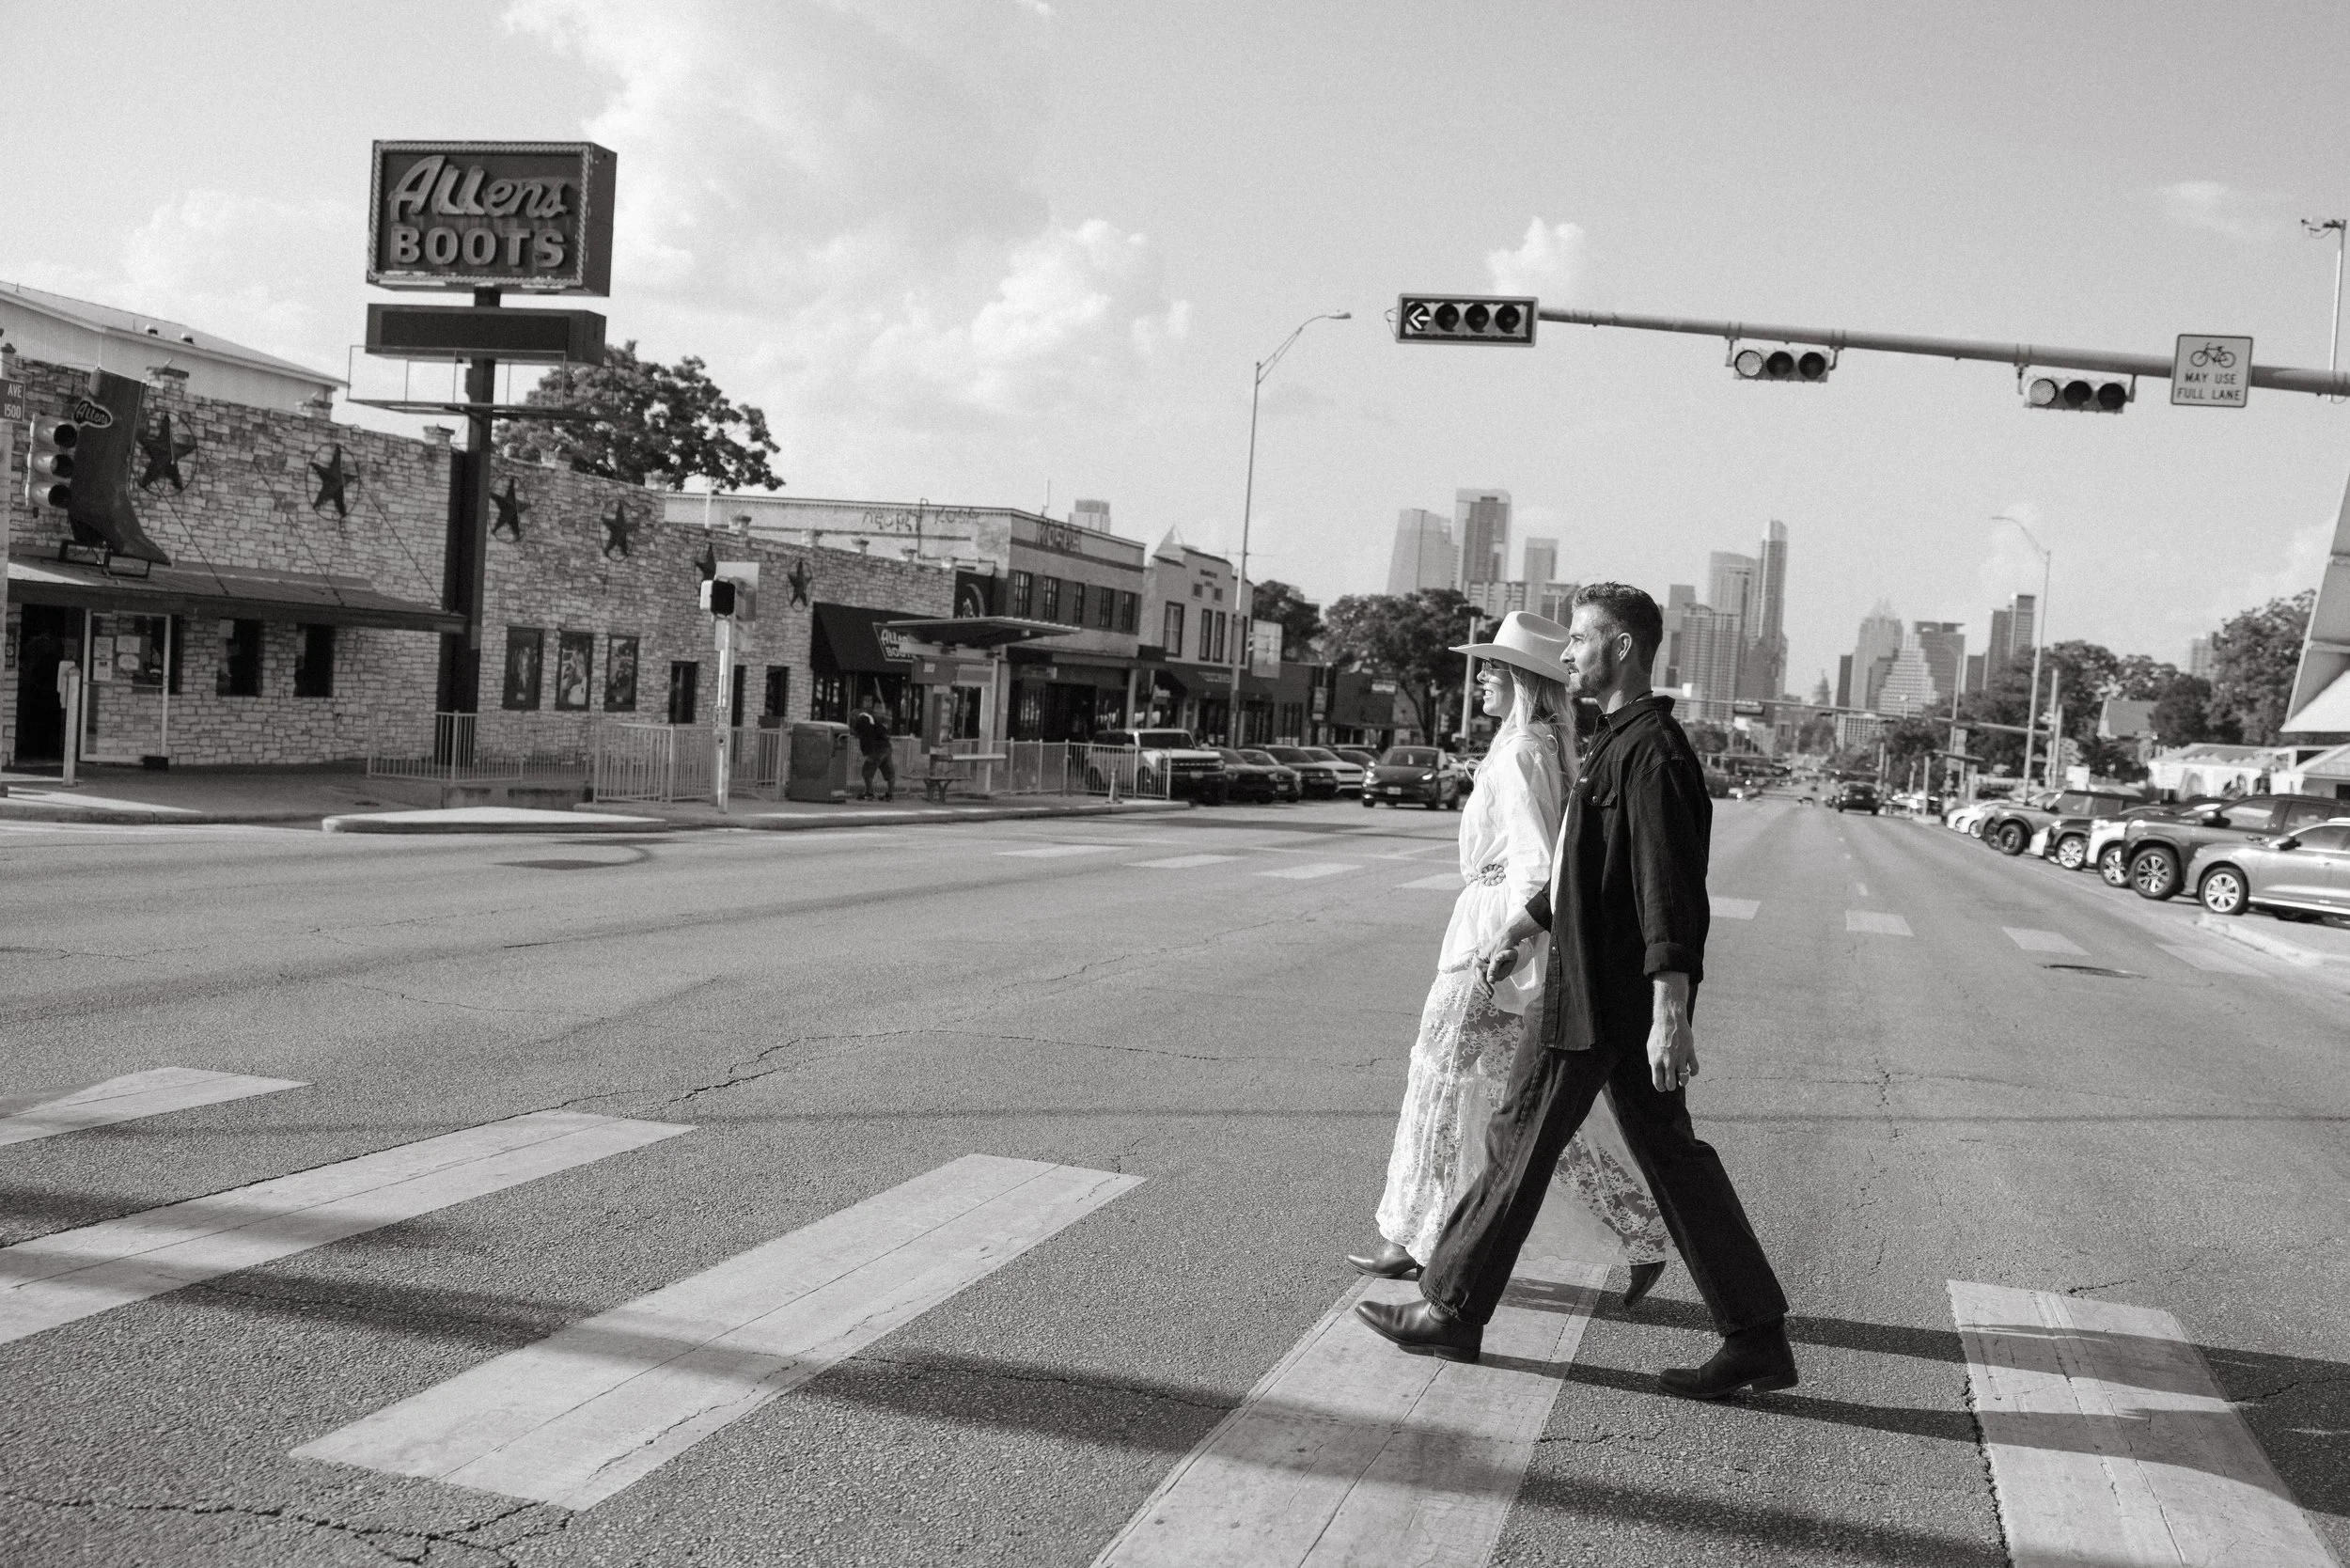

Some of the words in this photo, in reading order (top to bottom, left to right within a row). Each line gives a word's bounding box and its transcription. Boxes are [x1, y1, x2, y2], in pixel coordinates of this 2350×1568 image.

[387, 154, 569, 222] Allens
[389, 225, 565, 269] BOOTS
[2185, 372, 2208, 383] MAY
[2215, 373, 2237, 384] USE
[8, 384, 22, 399] AVE
[2177, 387, 2205, 400] FULL
[2212, 389, 2241, 400] LANE
[4, 403, 22, 419] 1500
[881, 629, 909, 646] Allen
